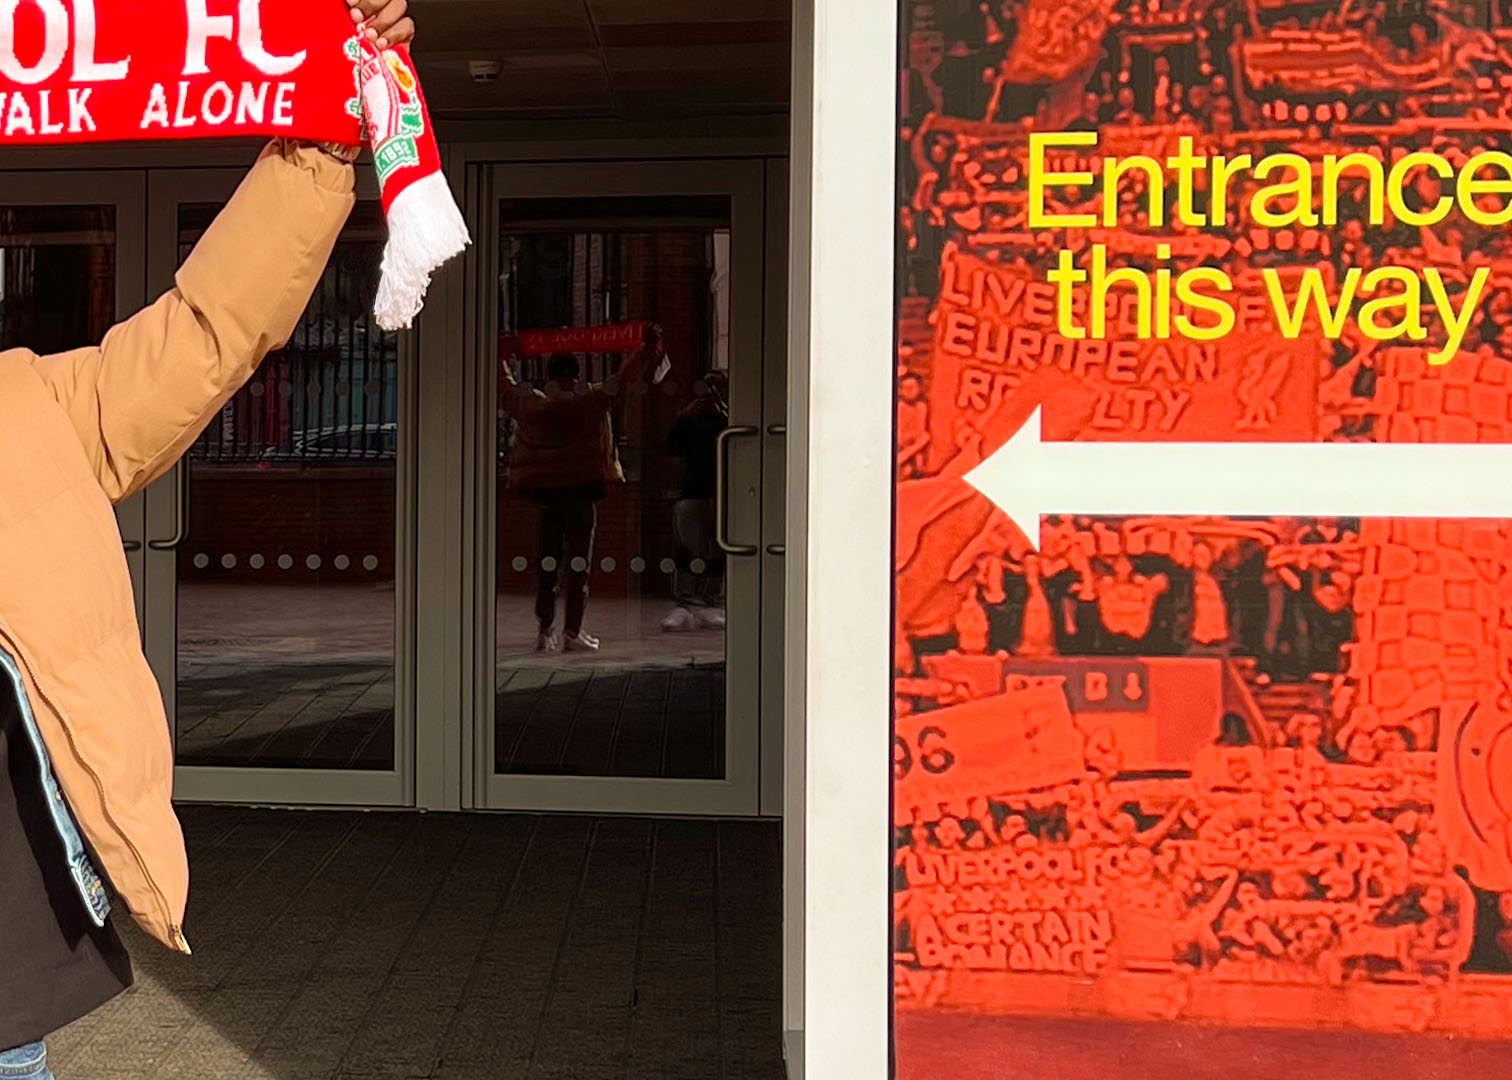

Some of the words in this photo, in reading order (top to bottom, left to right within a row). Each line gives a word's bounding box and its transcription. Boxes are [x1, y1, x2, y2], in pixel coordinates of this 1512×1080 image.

[141, 80, 296, 128] ALONE
[1029, 132, 1512, 227] Entrance
[1047, 244, 1236, 339] this
[1263, 267, 1491, 366] way
[943, 311, 1219, 384] EUROPEAN
[944, 909, 1114, 946] CERTAIN
